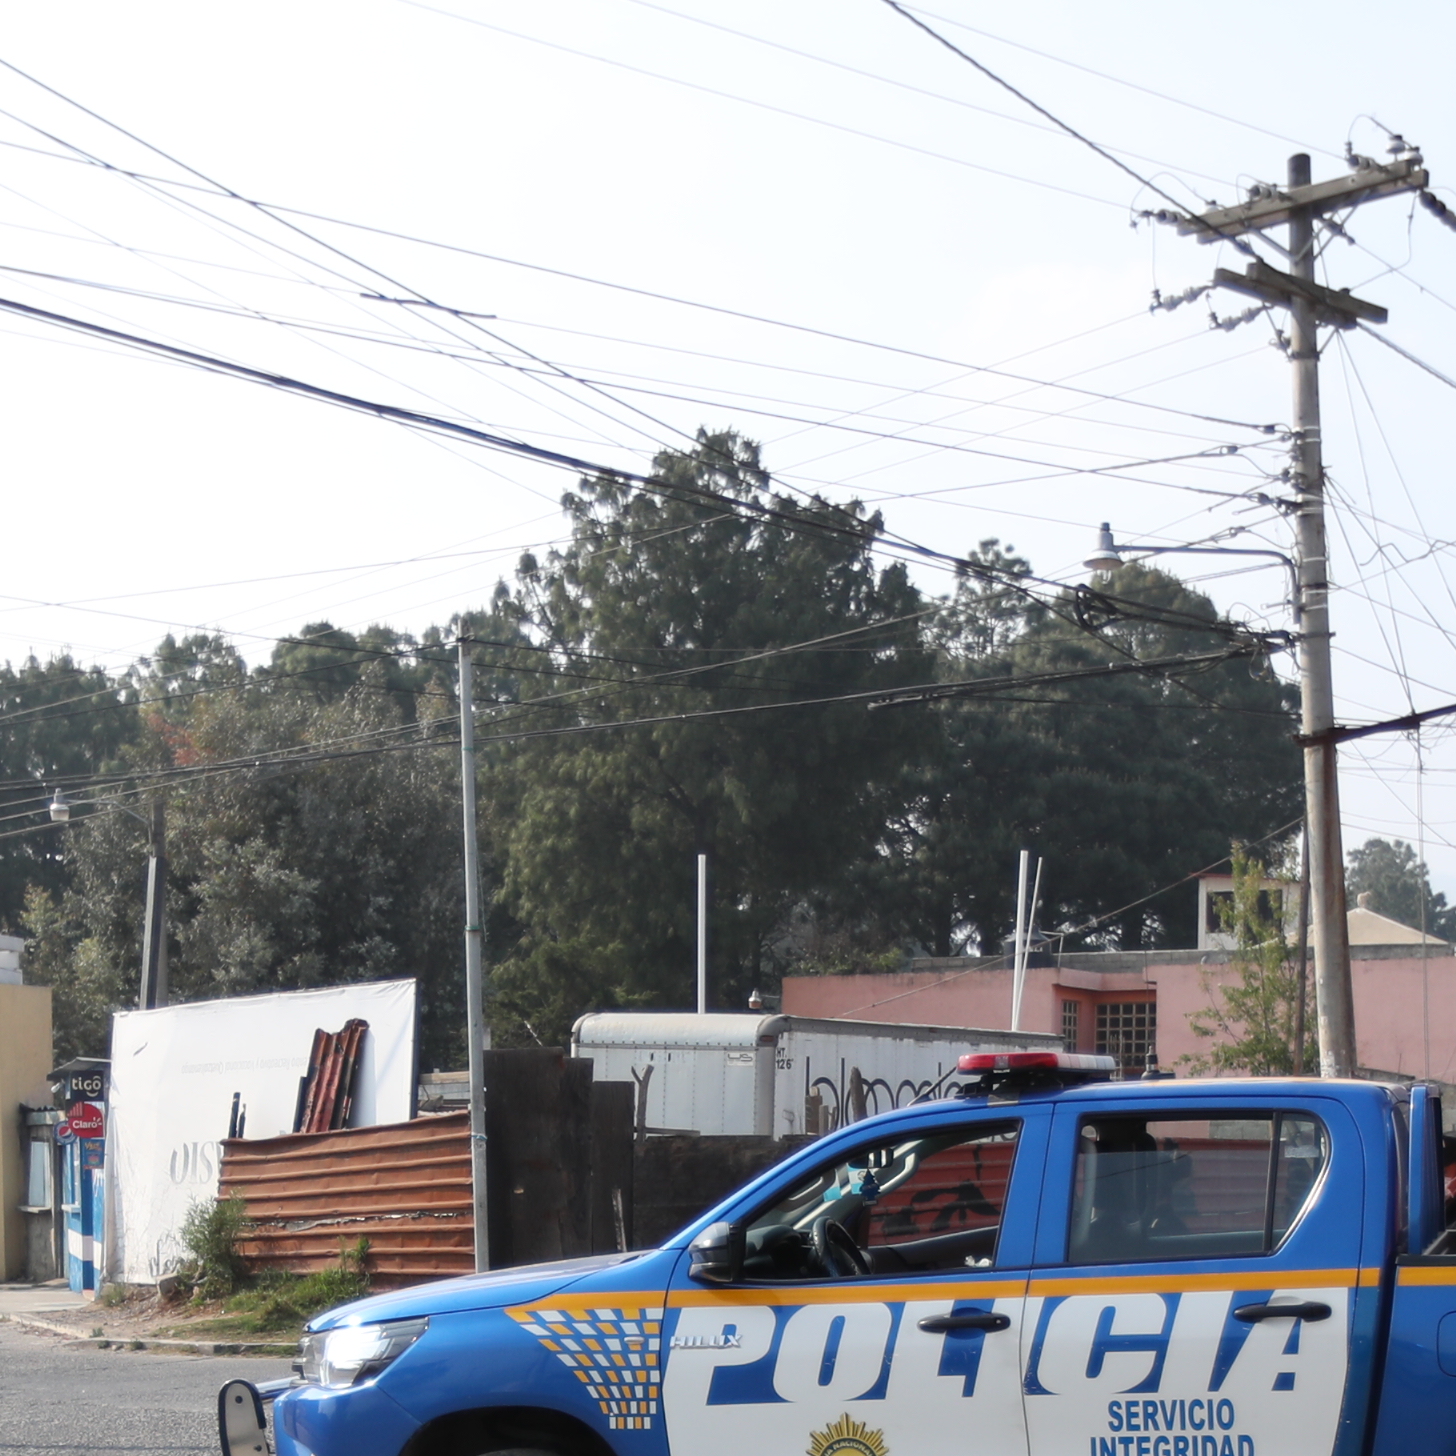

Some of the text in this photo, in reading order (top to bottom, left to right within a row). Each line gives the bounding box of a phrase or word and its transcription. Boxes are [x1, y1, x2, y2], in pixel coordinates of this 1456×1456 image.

[72, 1117, 99, 1129] Claro
[669, 1335, 743, 1349] HILUX
[1107, 1398, 1235, 1432] SERVICIO
